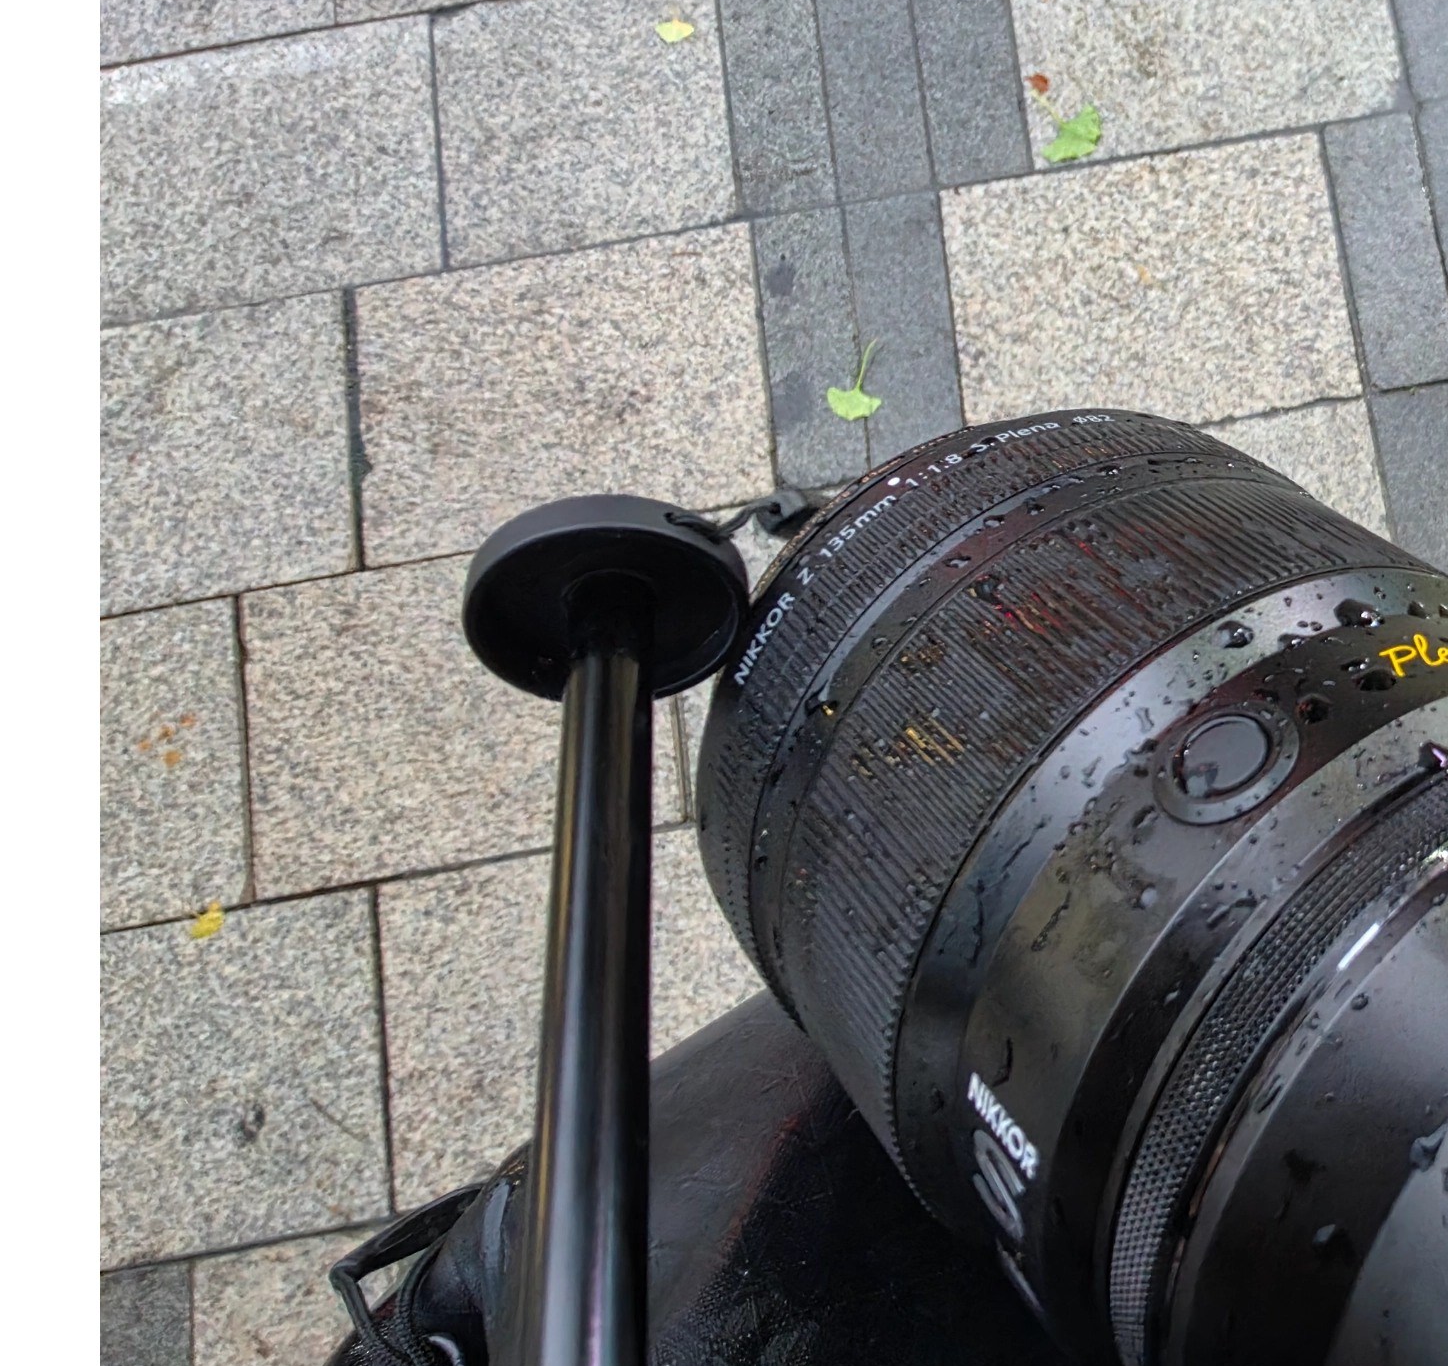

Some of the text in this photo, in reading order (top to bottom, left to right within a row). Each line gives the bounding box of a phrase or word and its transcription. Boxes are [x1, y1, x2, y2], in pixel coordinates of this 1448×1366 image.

[733, 592, 796, 685] NIKKOR
[797, 567, 815, 586] Z
[819, 494, 897, 559] 135mm
[995, 421, 1061, 443] Plena
[966, 1071, 1043, 1181] NIKKOR
